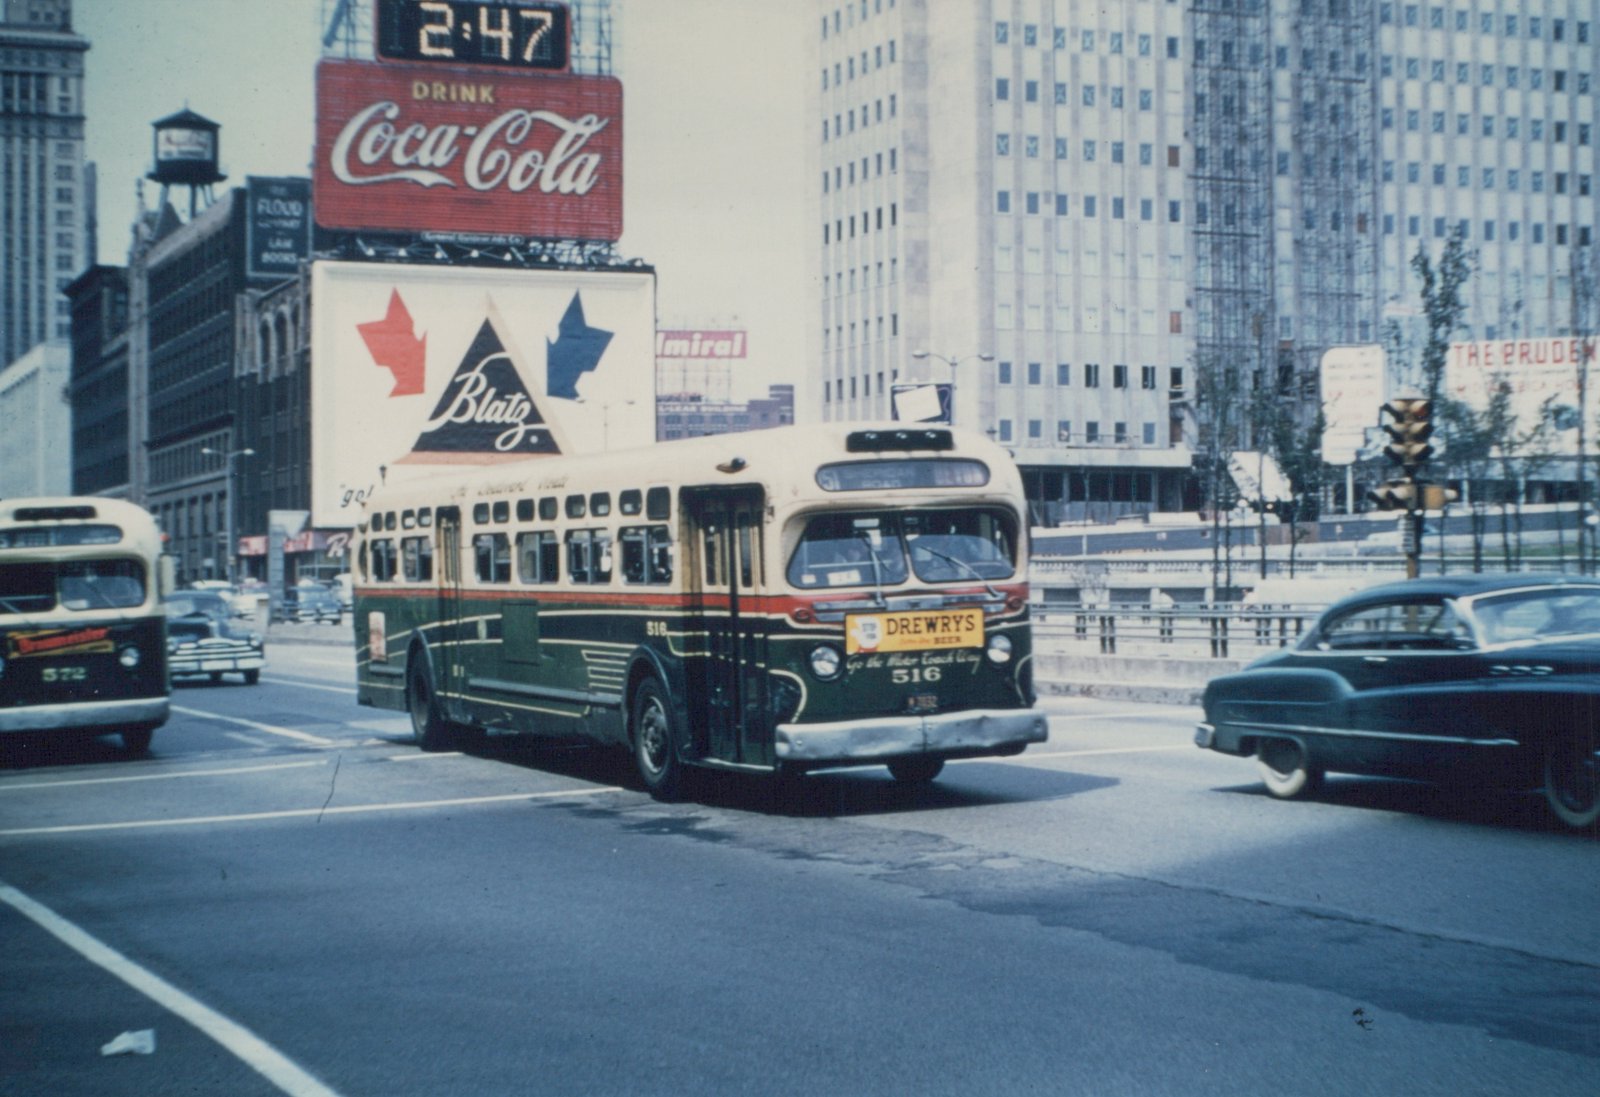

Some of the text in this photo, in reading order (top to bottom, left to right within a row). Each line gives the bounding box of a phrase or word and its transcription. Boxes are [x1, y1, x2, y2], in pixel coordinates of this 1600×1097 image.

[419, 2, 553, 62] 2:47
[412, 81, 495, 104] DRINK
[331, 101, 609, 195] Coca-Cola
[1454, 343, 1494, 369] THE
[421, 351, 550, 451] Blatz
[646, 620, 668, 637] 516
[886, 615, 976, 636] DREWRYS
[891, 666, 942, 684] 516
